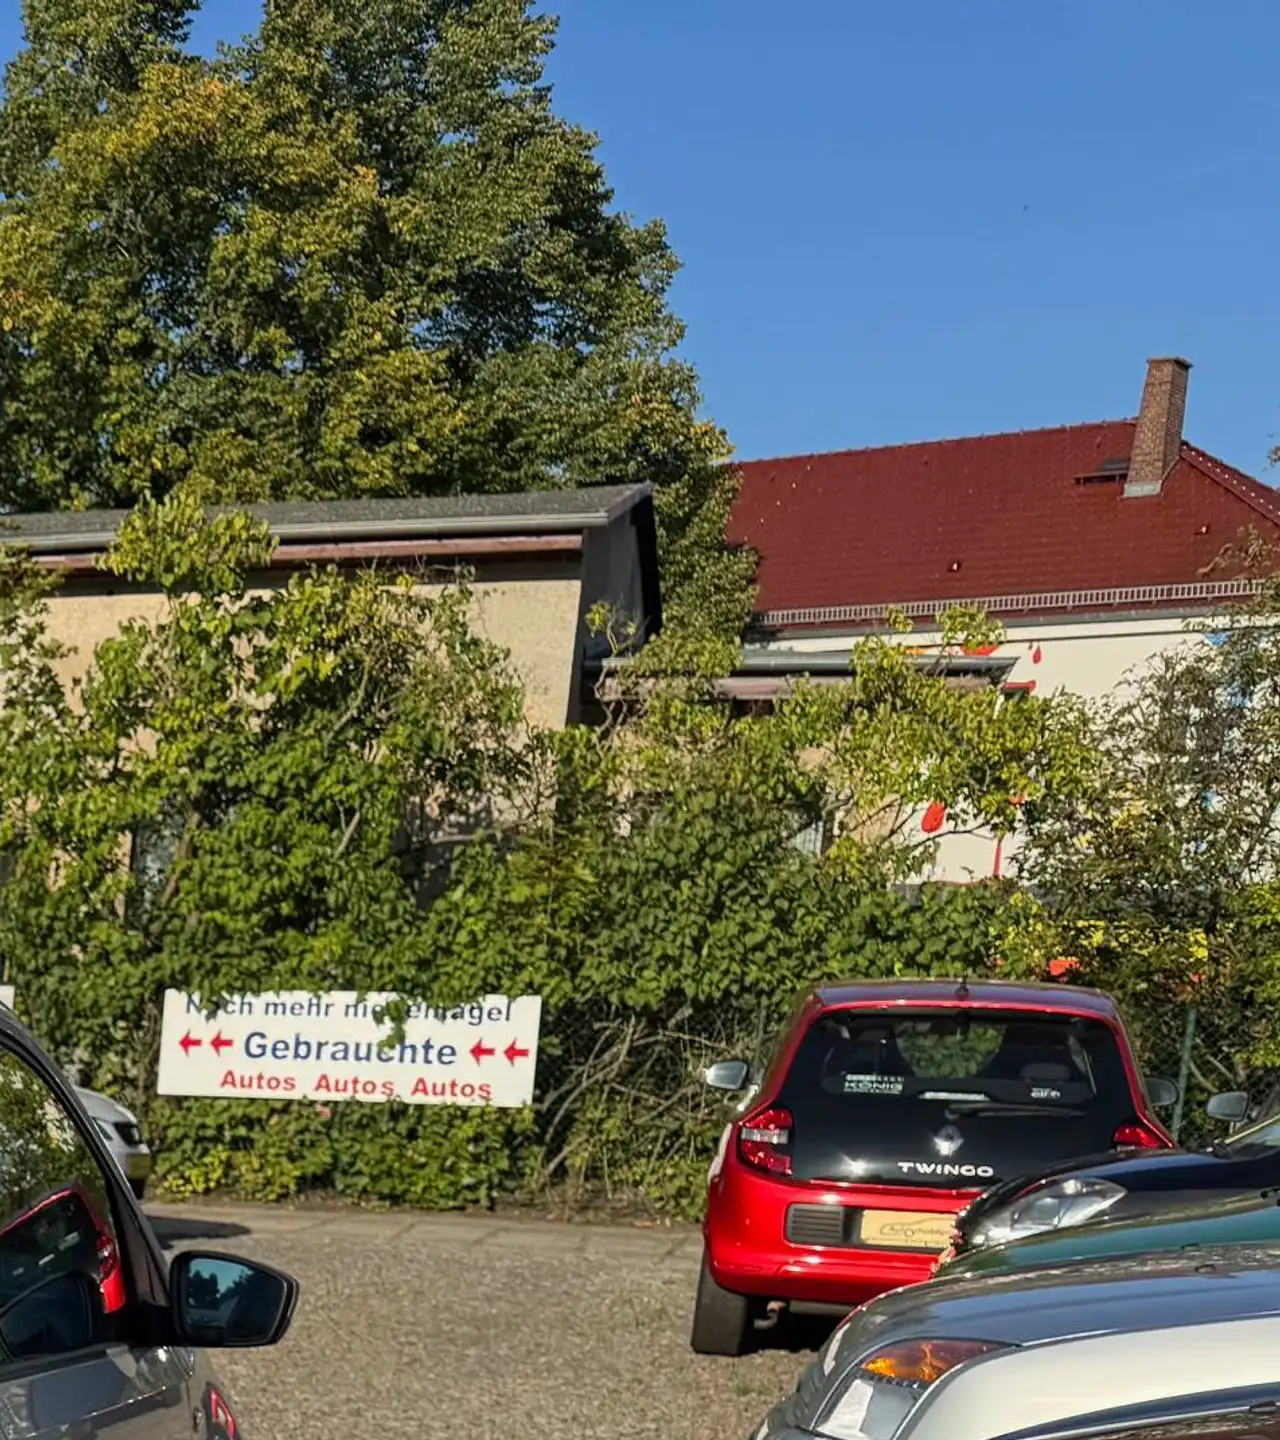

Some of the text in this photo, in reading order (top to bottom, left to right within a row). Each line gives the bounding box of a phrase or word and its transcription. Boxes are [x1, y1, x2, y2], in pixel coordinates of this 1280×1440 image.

[186, 998, 253, 1015] Nch
[264, 998, 334, 1017] mehr
[244, 1031, 458, 1065] Gebrauchte
[220, 1070, 493, 1101] Autos Autos Autos
[897, 1161, 994, 1177] TWINGO
